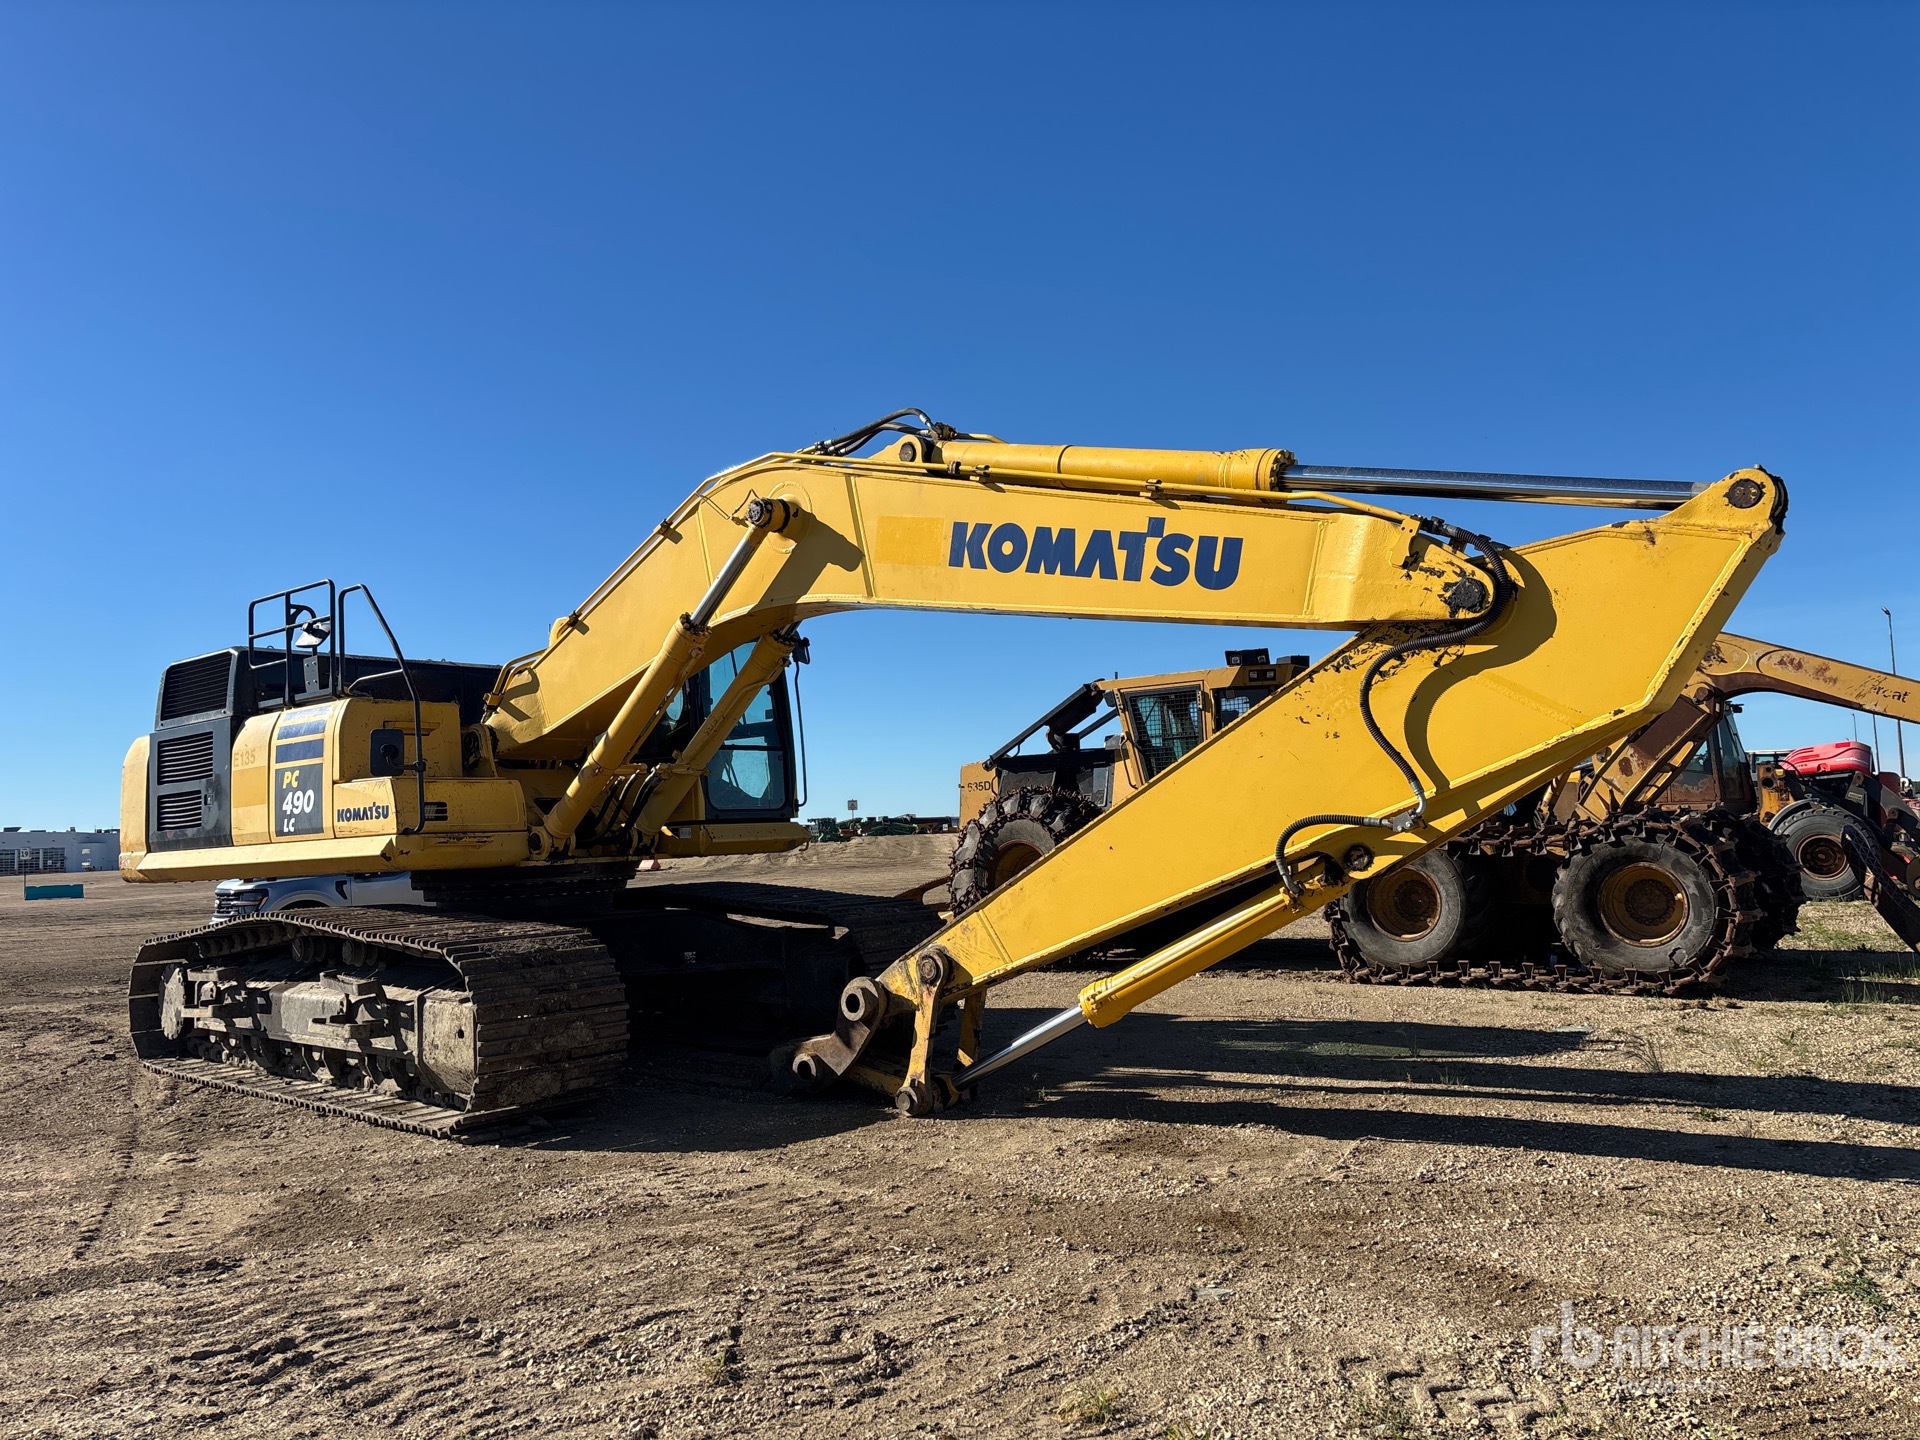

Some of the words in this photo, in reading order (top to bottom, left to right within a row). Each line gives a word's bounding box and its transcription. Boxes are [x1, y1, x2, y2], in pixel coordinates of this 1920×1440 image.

[949, 517, 1243, 590] KOMATSU
[233, 750, 256, 768] E135
[282, 769, 300, 789] PC
[282, 789, 315, 815] 490
[336, 802, 390, 822] KOMATSU
[283, 818, 295, 833] LC
